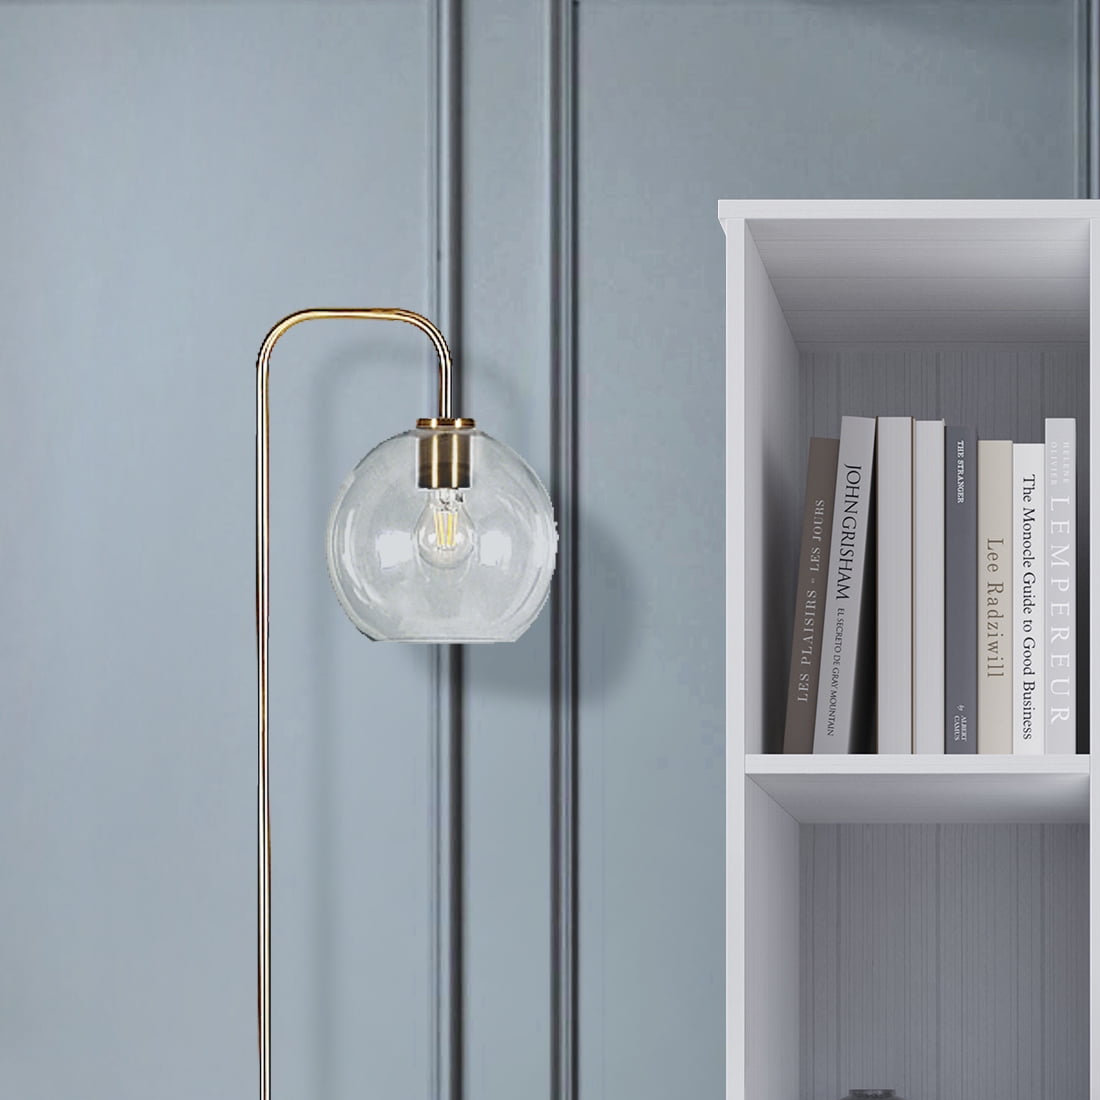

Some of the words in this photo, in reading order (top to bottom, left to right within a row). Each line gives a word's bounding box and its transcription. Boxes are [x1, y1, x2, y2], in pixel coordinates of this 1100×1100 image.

[1022, 474, 1036, 502] The
[812, 499, 825, 543] JOURS
[1022, 508, 1036, 568] Monocle
[810, 550, 820, 572] LES
[987, 538, 1004, 573] Lee
[1022, 572, 1036, 614] Guide
[1050, 496, 1070, 724] LEMPEREUR
[800, 589, 818, 668] PLAISIRS
[838, 608, 845, 618] EL
[987, 582, 1004, 678] Radziwill
[1022, 620, 1032, 632] to
[836, 618, 844, 654] SECRETO
[834, 654, 842, 666] DE
[1022, 636, 1036, 676] Good
[798, 674, 808, 702] LES
[832, 666, 840, 690] GRAY
[827, 690, 838, 737] MOUNTAIN
[1022, 682, 1036, 740] Business
